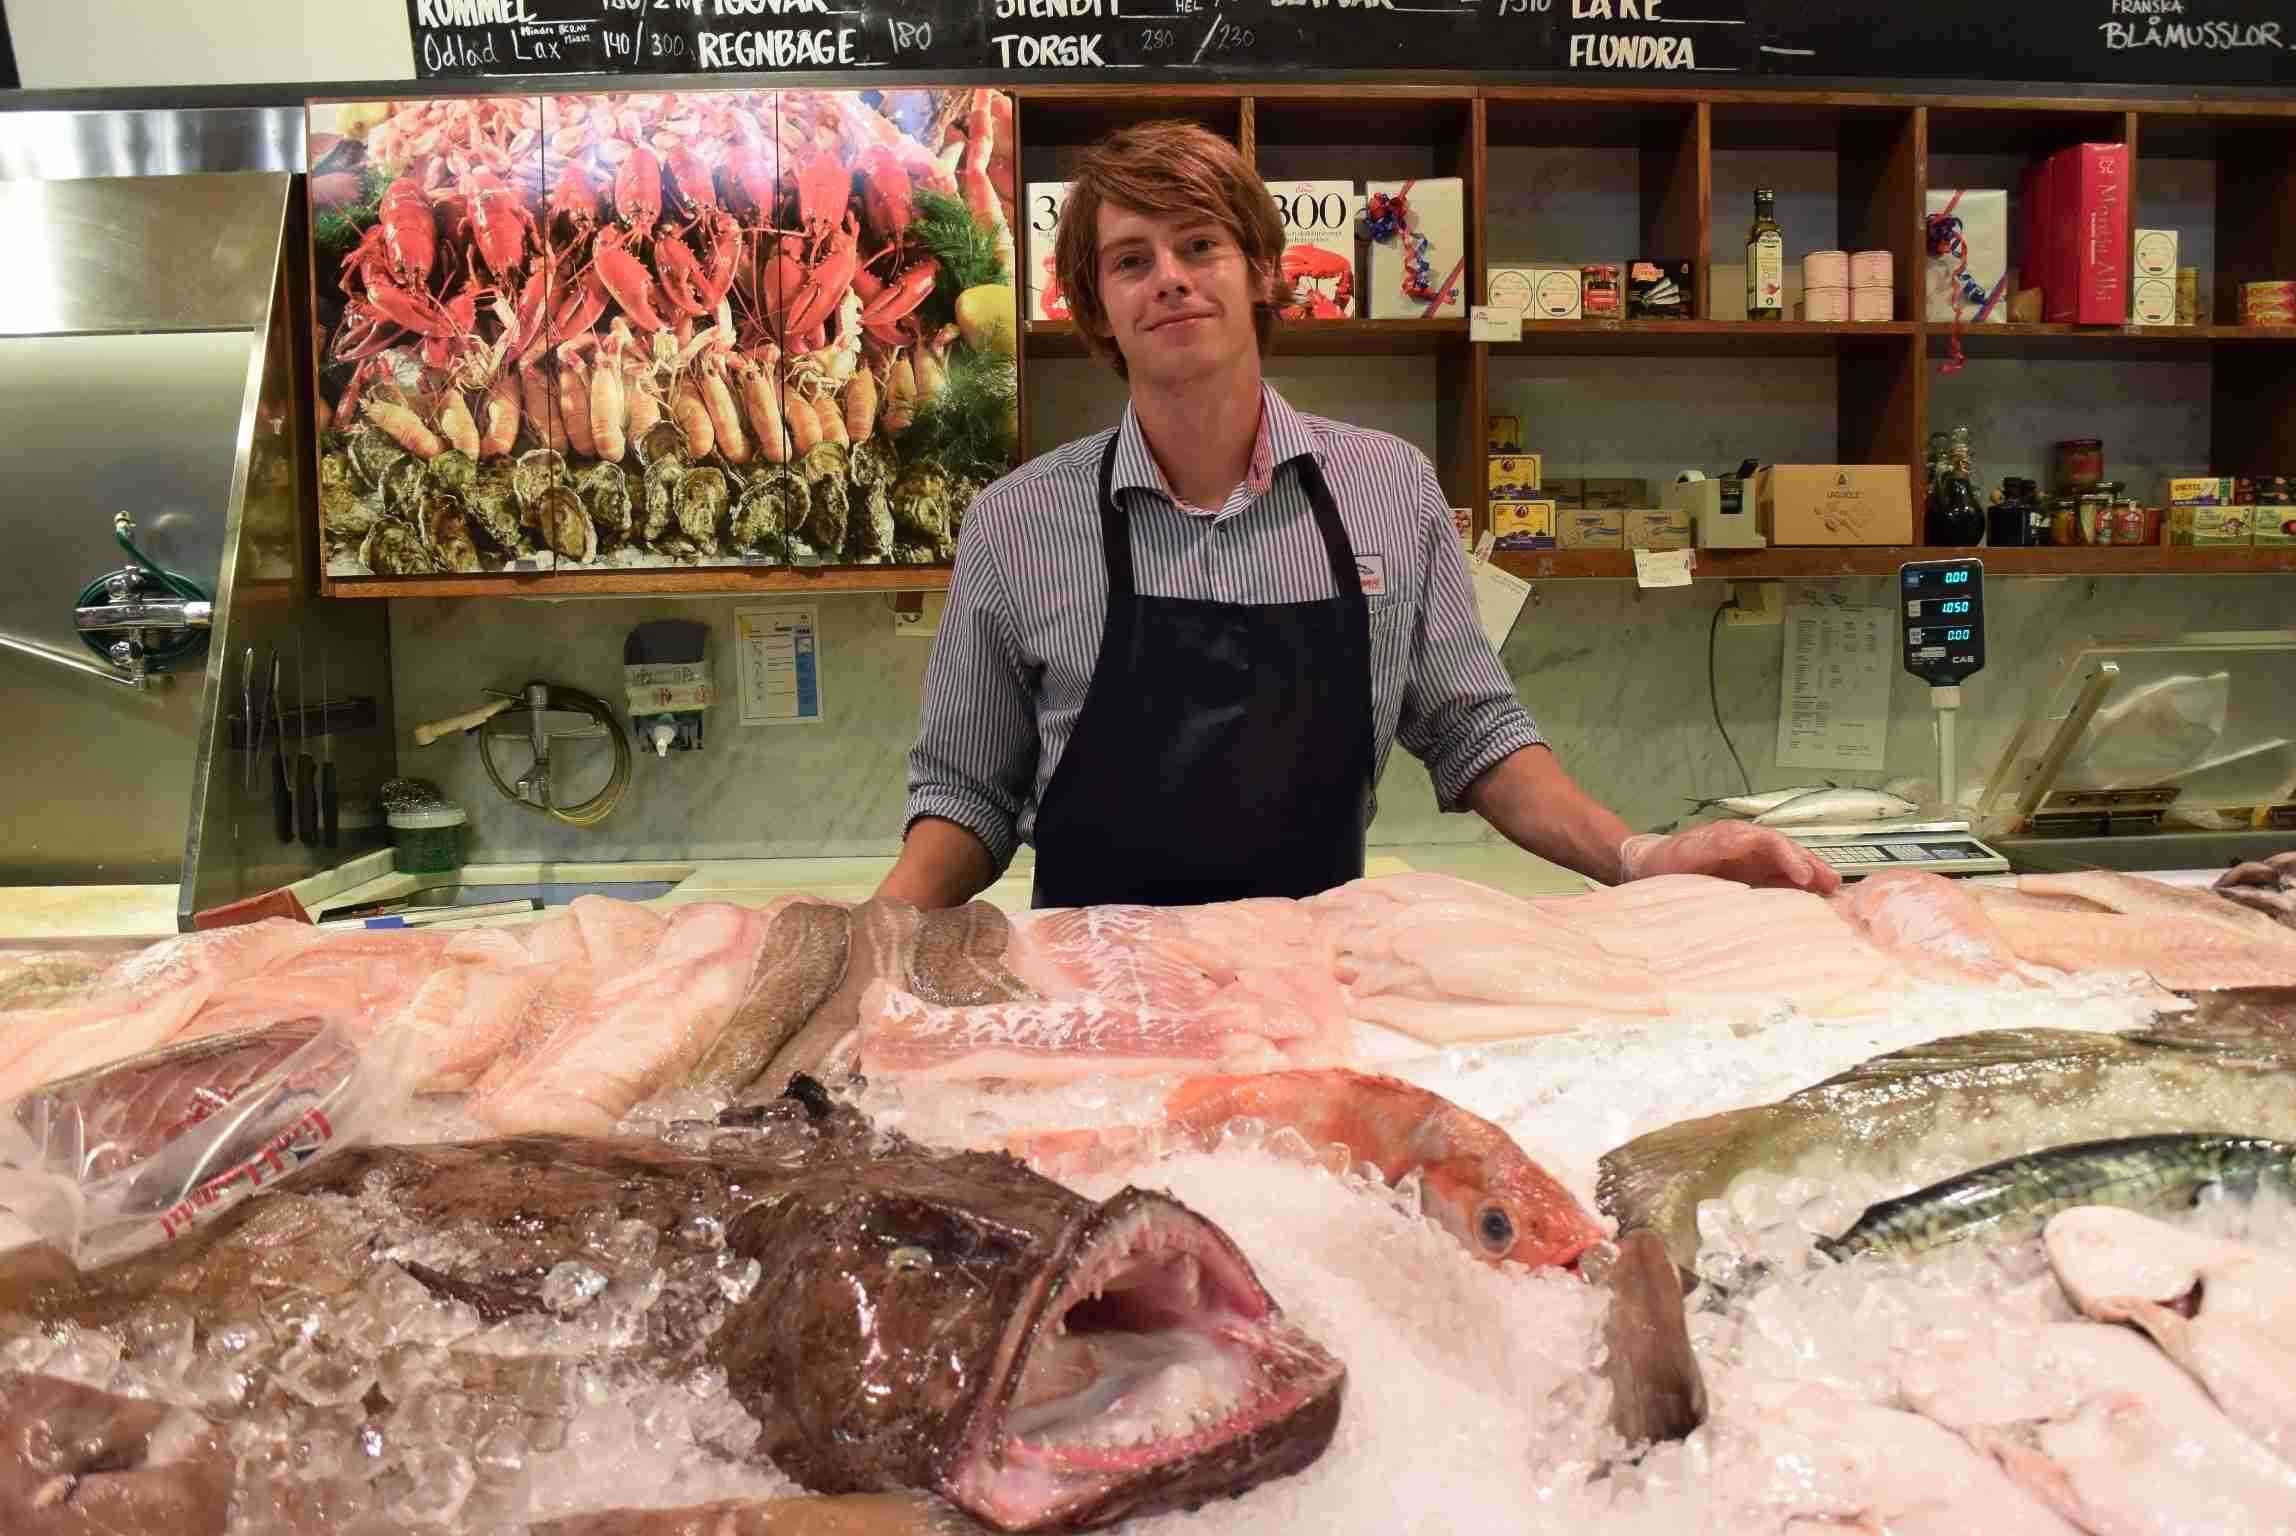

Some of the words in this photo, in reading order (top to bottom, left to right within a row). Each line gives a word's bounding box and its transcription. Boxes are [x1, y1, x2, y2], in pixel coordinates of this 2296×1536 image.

[511, 28, 560, 60] Lax
[2097, 16, 2283, 49] BLÅMUSSLOR
[992, 34, 1105, 68] TORSK
[1569, 34, 1695, 70] FLUNDRA
